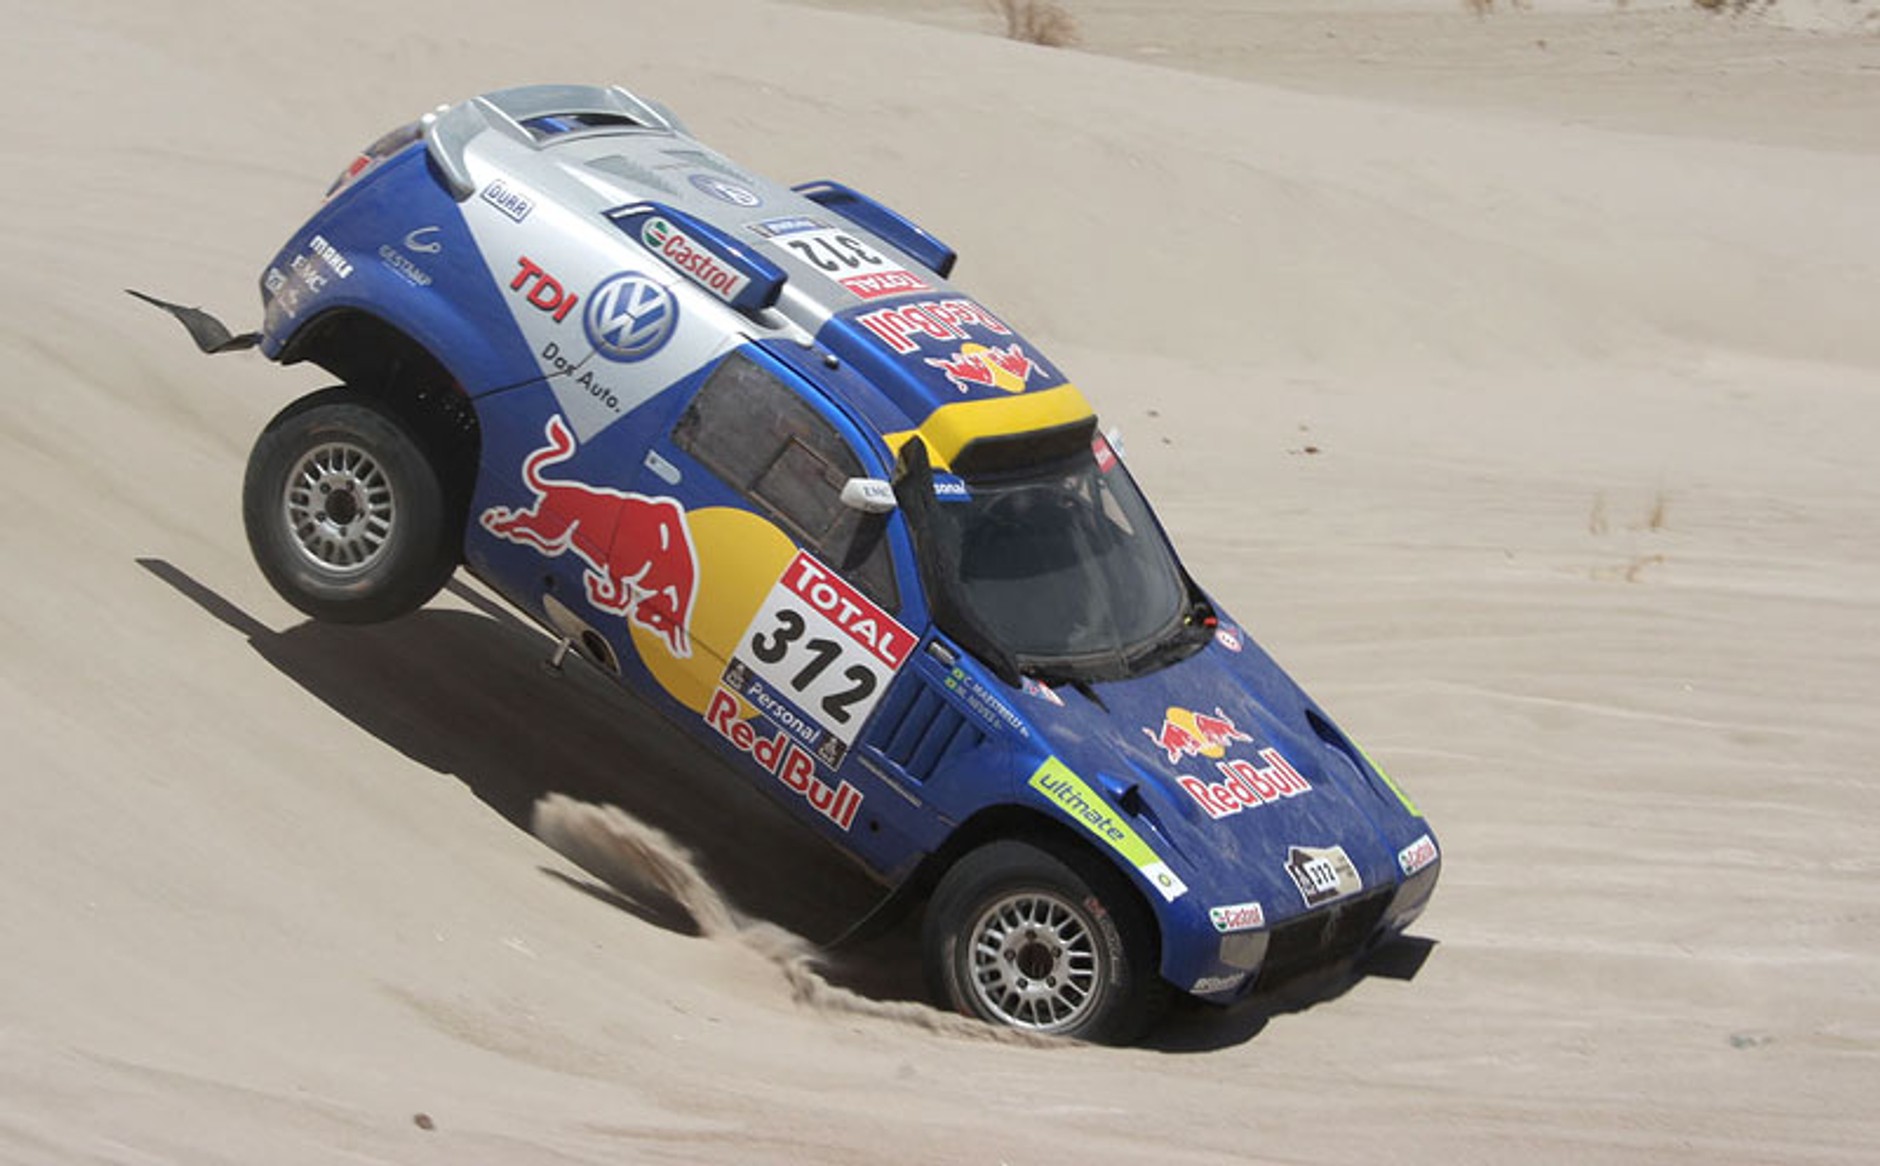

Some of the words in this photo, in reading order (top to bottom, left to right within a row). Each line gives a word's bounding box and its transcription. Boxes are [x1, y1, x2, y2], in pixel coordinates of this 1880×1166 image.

[662, 234, 740, 297] Castrol
[788, 235, 883, 271] 312
[509, 256, 580, 324] TDI
[541, 342, 576, 377] Das
[578, 370, 621, 413] Auto.
[799, 558, 897, 664] TOTAL
[752, 608, 878, 725] 312
[747, 681, 822, 744] Personal
[1039, 773, 1126, 842] ultimate
[1309, 861, 1337, 885] 312
